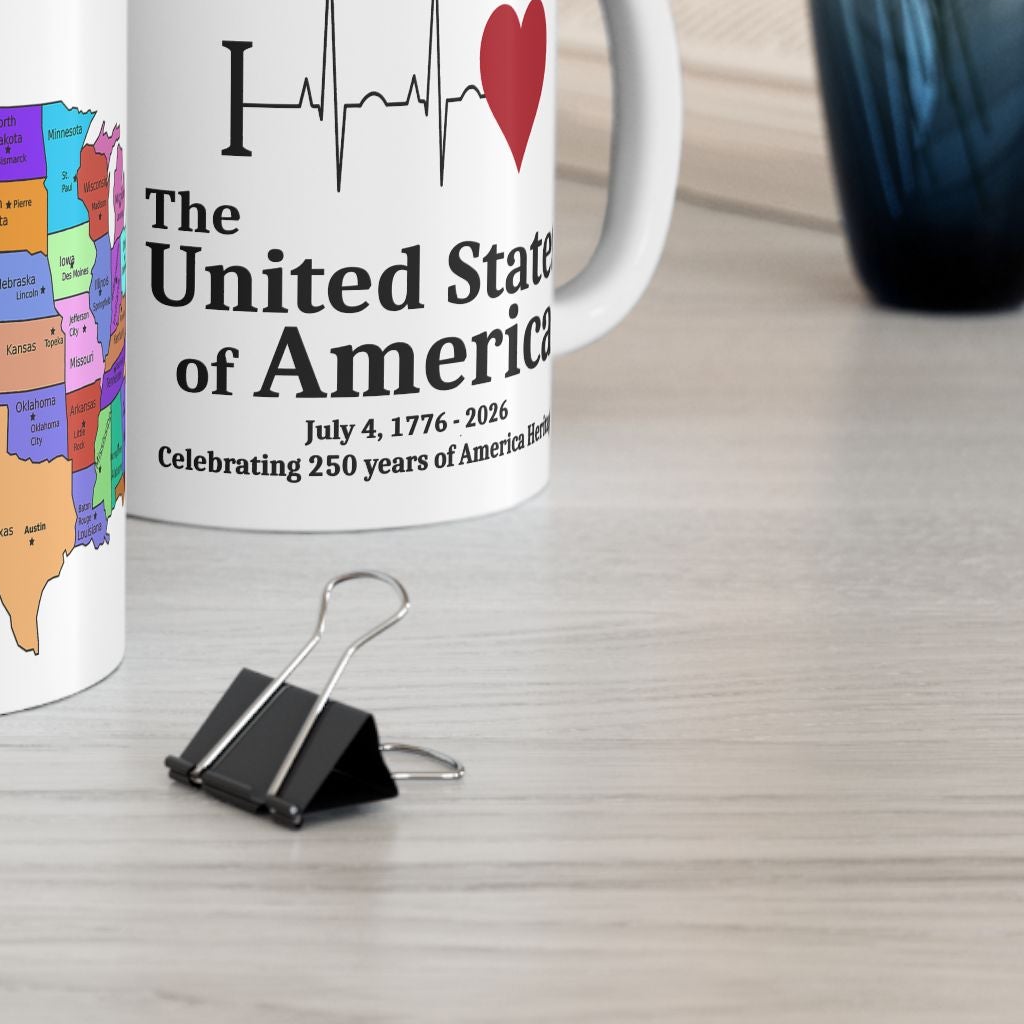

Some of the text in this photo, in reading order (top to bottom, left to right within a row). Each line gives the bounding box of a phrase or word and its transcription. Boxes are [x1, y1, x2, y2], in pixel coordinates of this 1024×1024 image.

[221, 40, 253, 157] I
[48, 125, 83, 141] Minnesota
[13, 198, 33, 209] Pierre
[145, 187, 241, 235] The
[145, 241, 425, 314] United
[448, 224, 553, 305] State
[16, 290, 39, 300] Lincoln
[6, 341, 37, 356] Kansas
[176, 303, 551, 399] of America
[16, 395, 56, 413] Oklahoma
[70, 399, 96, 416] Arkansas
[304, 418, 356, 446] July
[361, 417, 384, 441] 4,
[392, 411, 448, 437] 1776
[465, 399, 509, 429] 2026
[30, 436, 43, 447] City
[158, 445, 302, 483] Celebrating
[308, 454, 358, 477] 250
[363, 450, 429, 481] years
[434, 444, 457, 469] of
[458, 432, 525, 466] America
[24, 522, 46, 534] Austin
